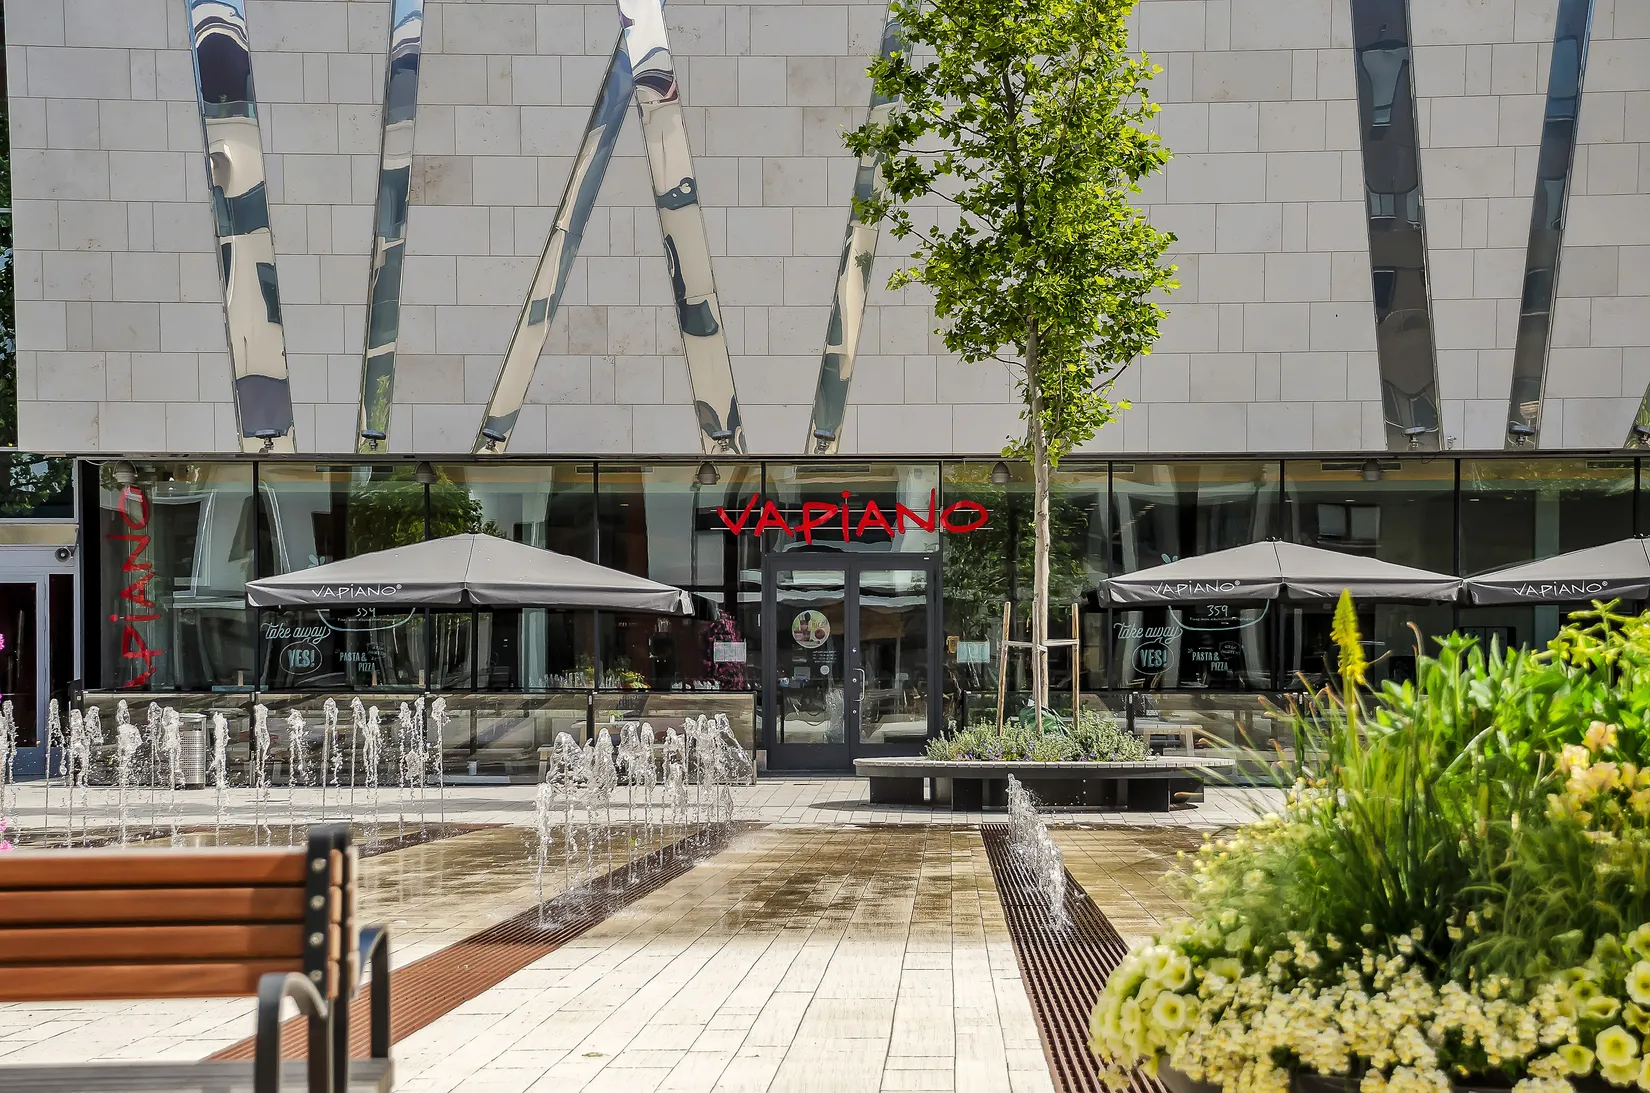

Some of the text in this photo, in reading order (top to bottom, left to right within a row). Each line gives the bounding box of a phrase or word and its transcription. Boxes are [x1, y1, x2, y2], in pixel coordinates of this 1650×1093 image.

[1207, 604, 1228, 617] 359
[293, 624, 331, 644] away
[1145, 624, 1183, 644] away
[287, 649, 315, 668] YES!
[340, 652, 367, 661] PASTA &
[1140, 649, 1167, 668] YES!
[1192, 652, 1220, 661] PASTA &
[358, 662, 376, 672] PIZZA
[1211, 661, 1229, 671] PIZZA
